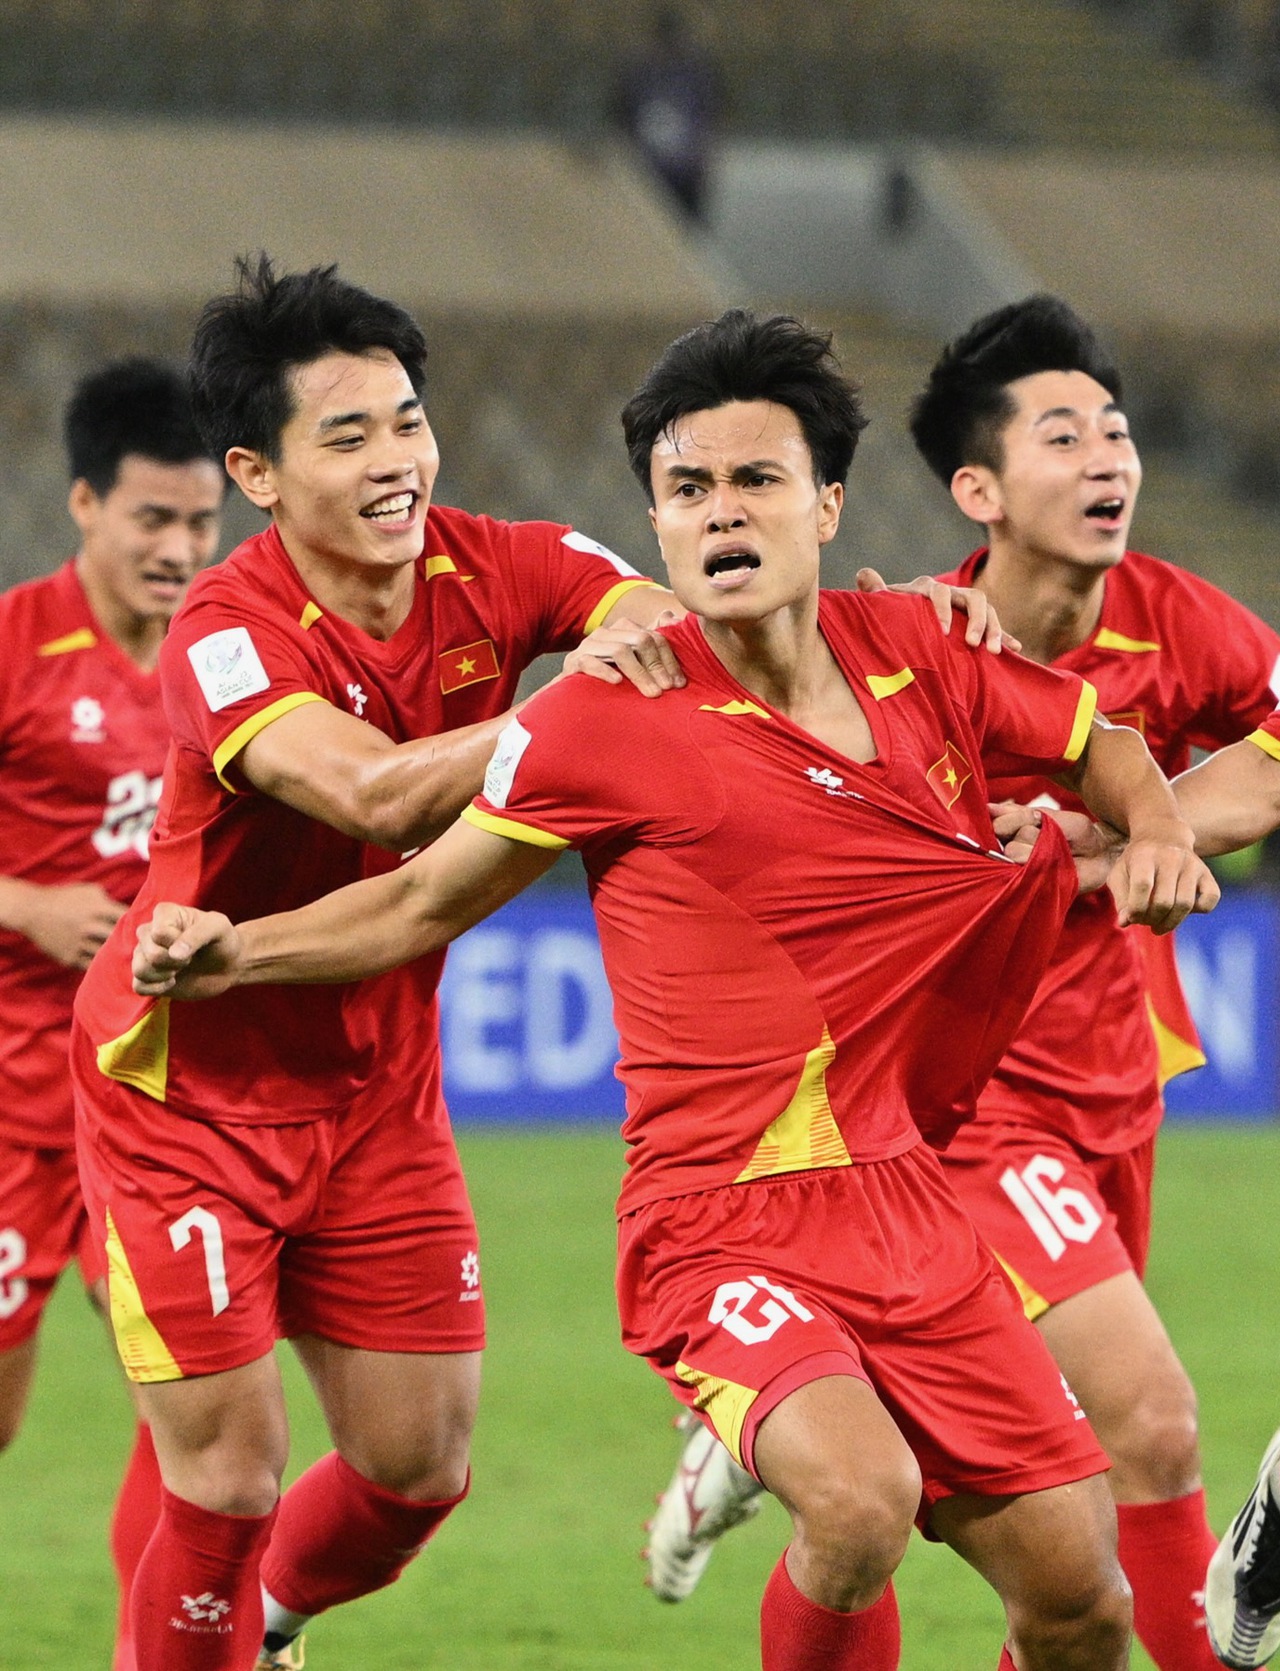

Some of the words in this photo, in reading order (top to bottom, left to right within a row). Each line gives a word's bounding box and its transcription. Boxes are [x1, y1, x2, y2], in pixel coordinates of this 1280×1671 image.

[168, 1205, 230, 1317] 7
[1000, 1154, 1102, 1261] 16
[708, 1275, 815, 1346] 21
